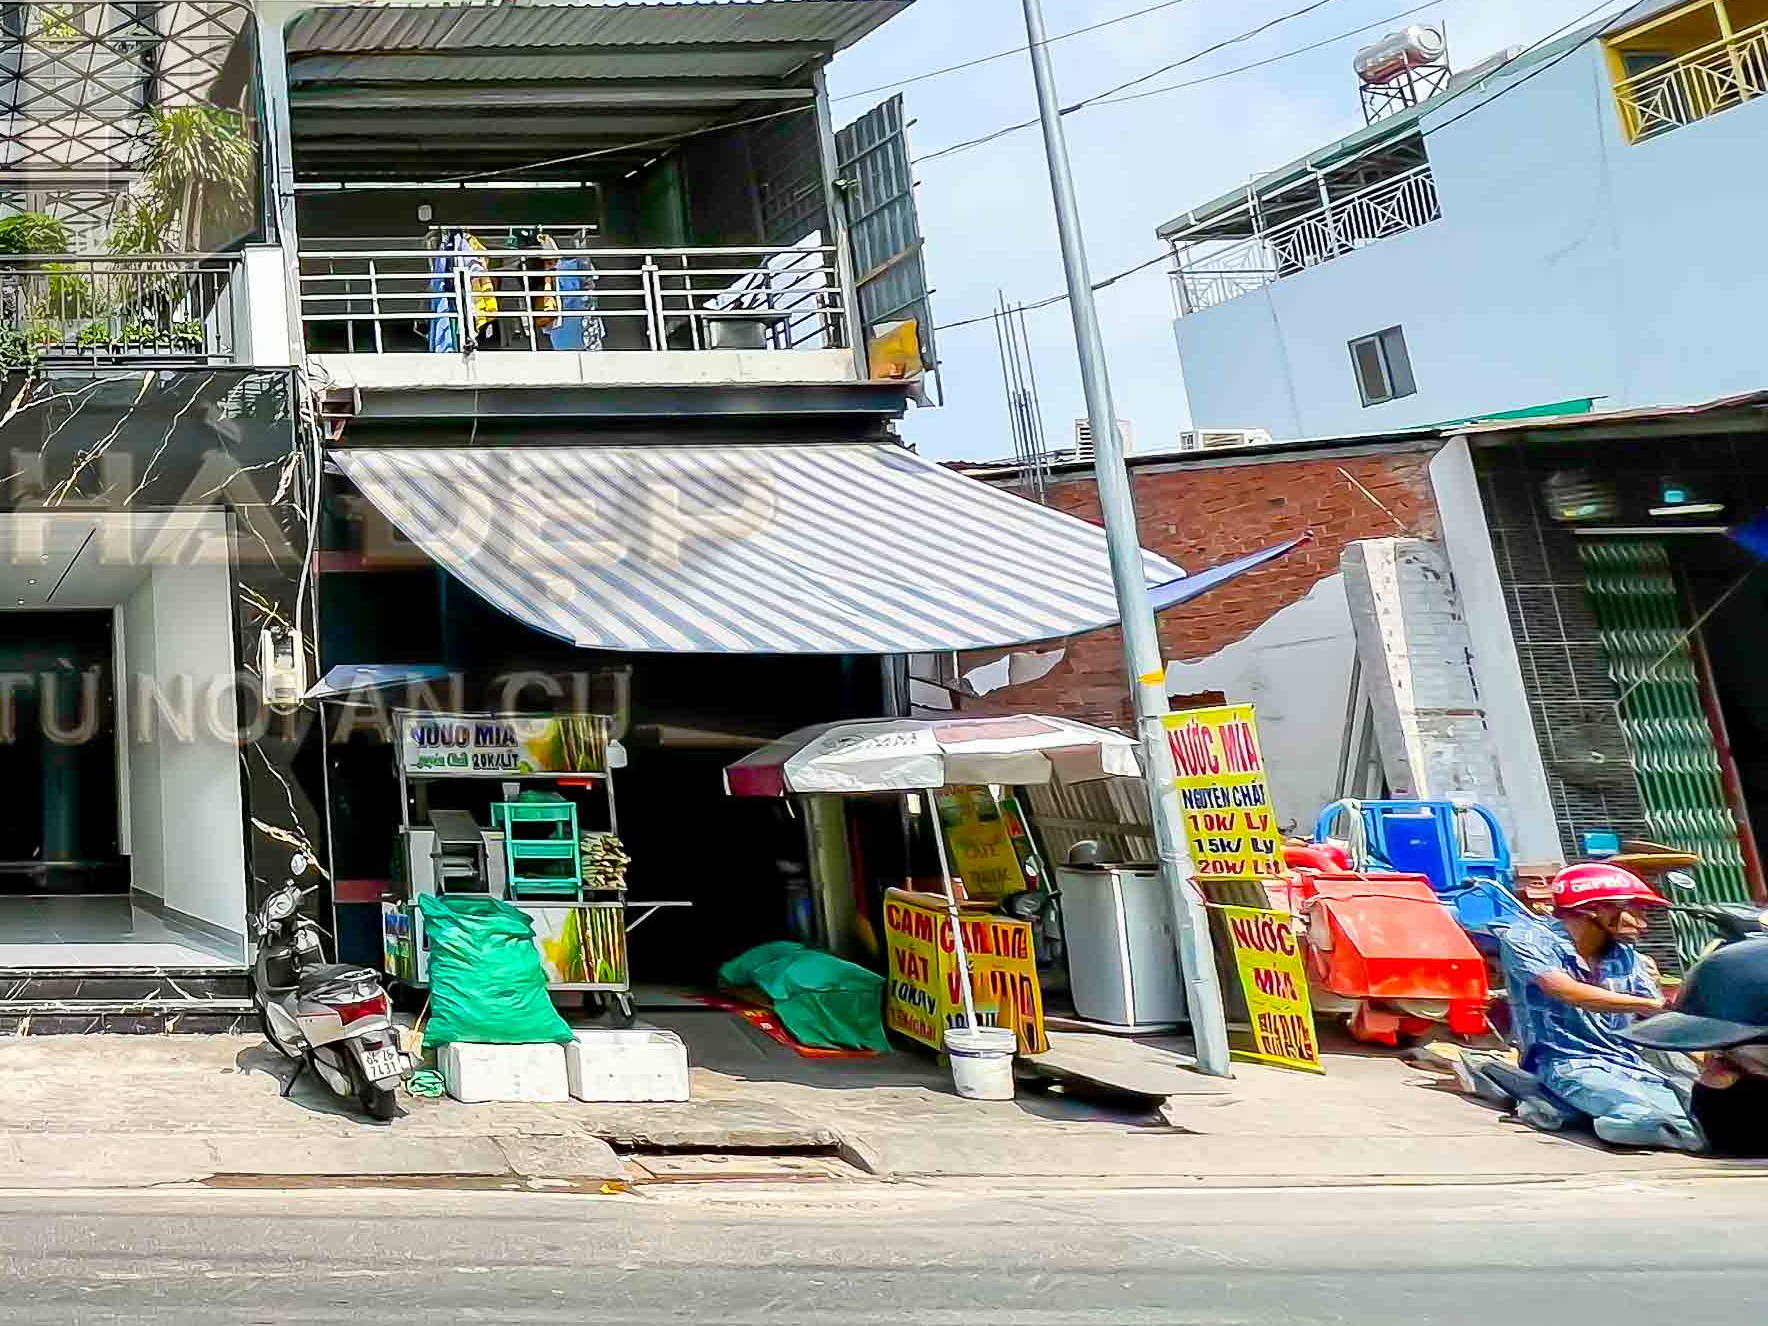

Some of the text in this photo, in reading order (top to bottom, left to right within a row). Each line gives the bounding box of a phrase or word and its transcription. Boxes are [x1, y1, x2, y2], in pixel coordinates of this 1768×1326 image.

[1167, 712, 1261, 776] NƯỚC MÍA
[1182, 782, 1231, 809] NGUYÊN
[886, 903, 934, 944] CAM
[1231, 914, 1295, 956] NƯỚC
